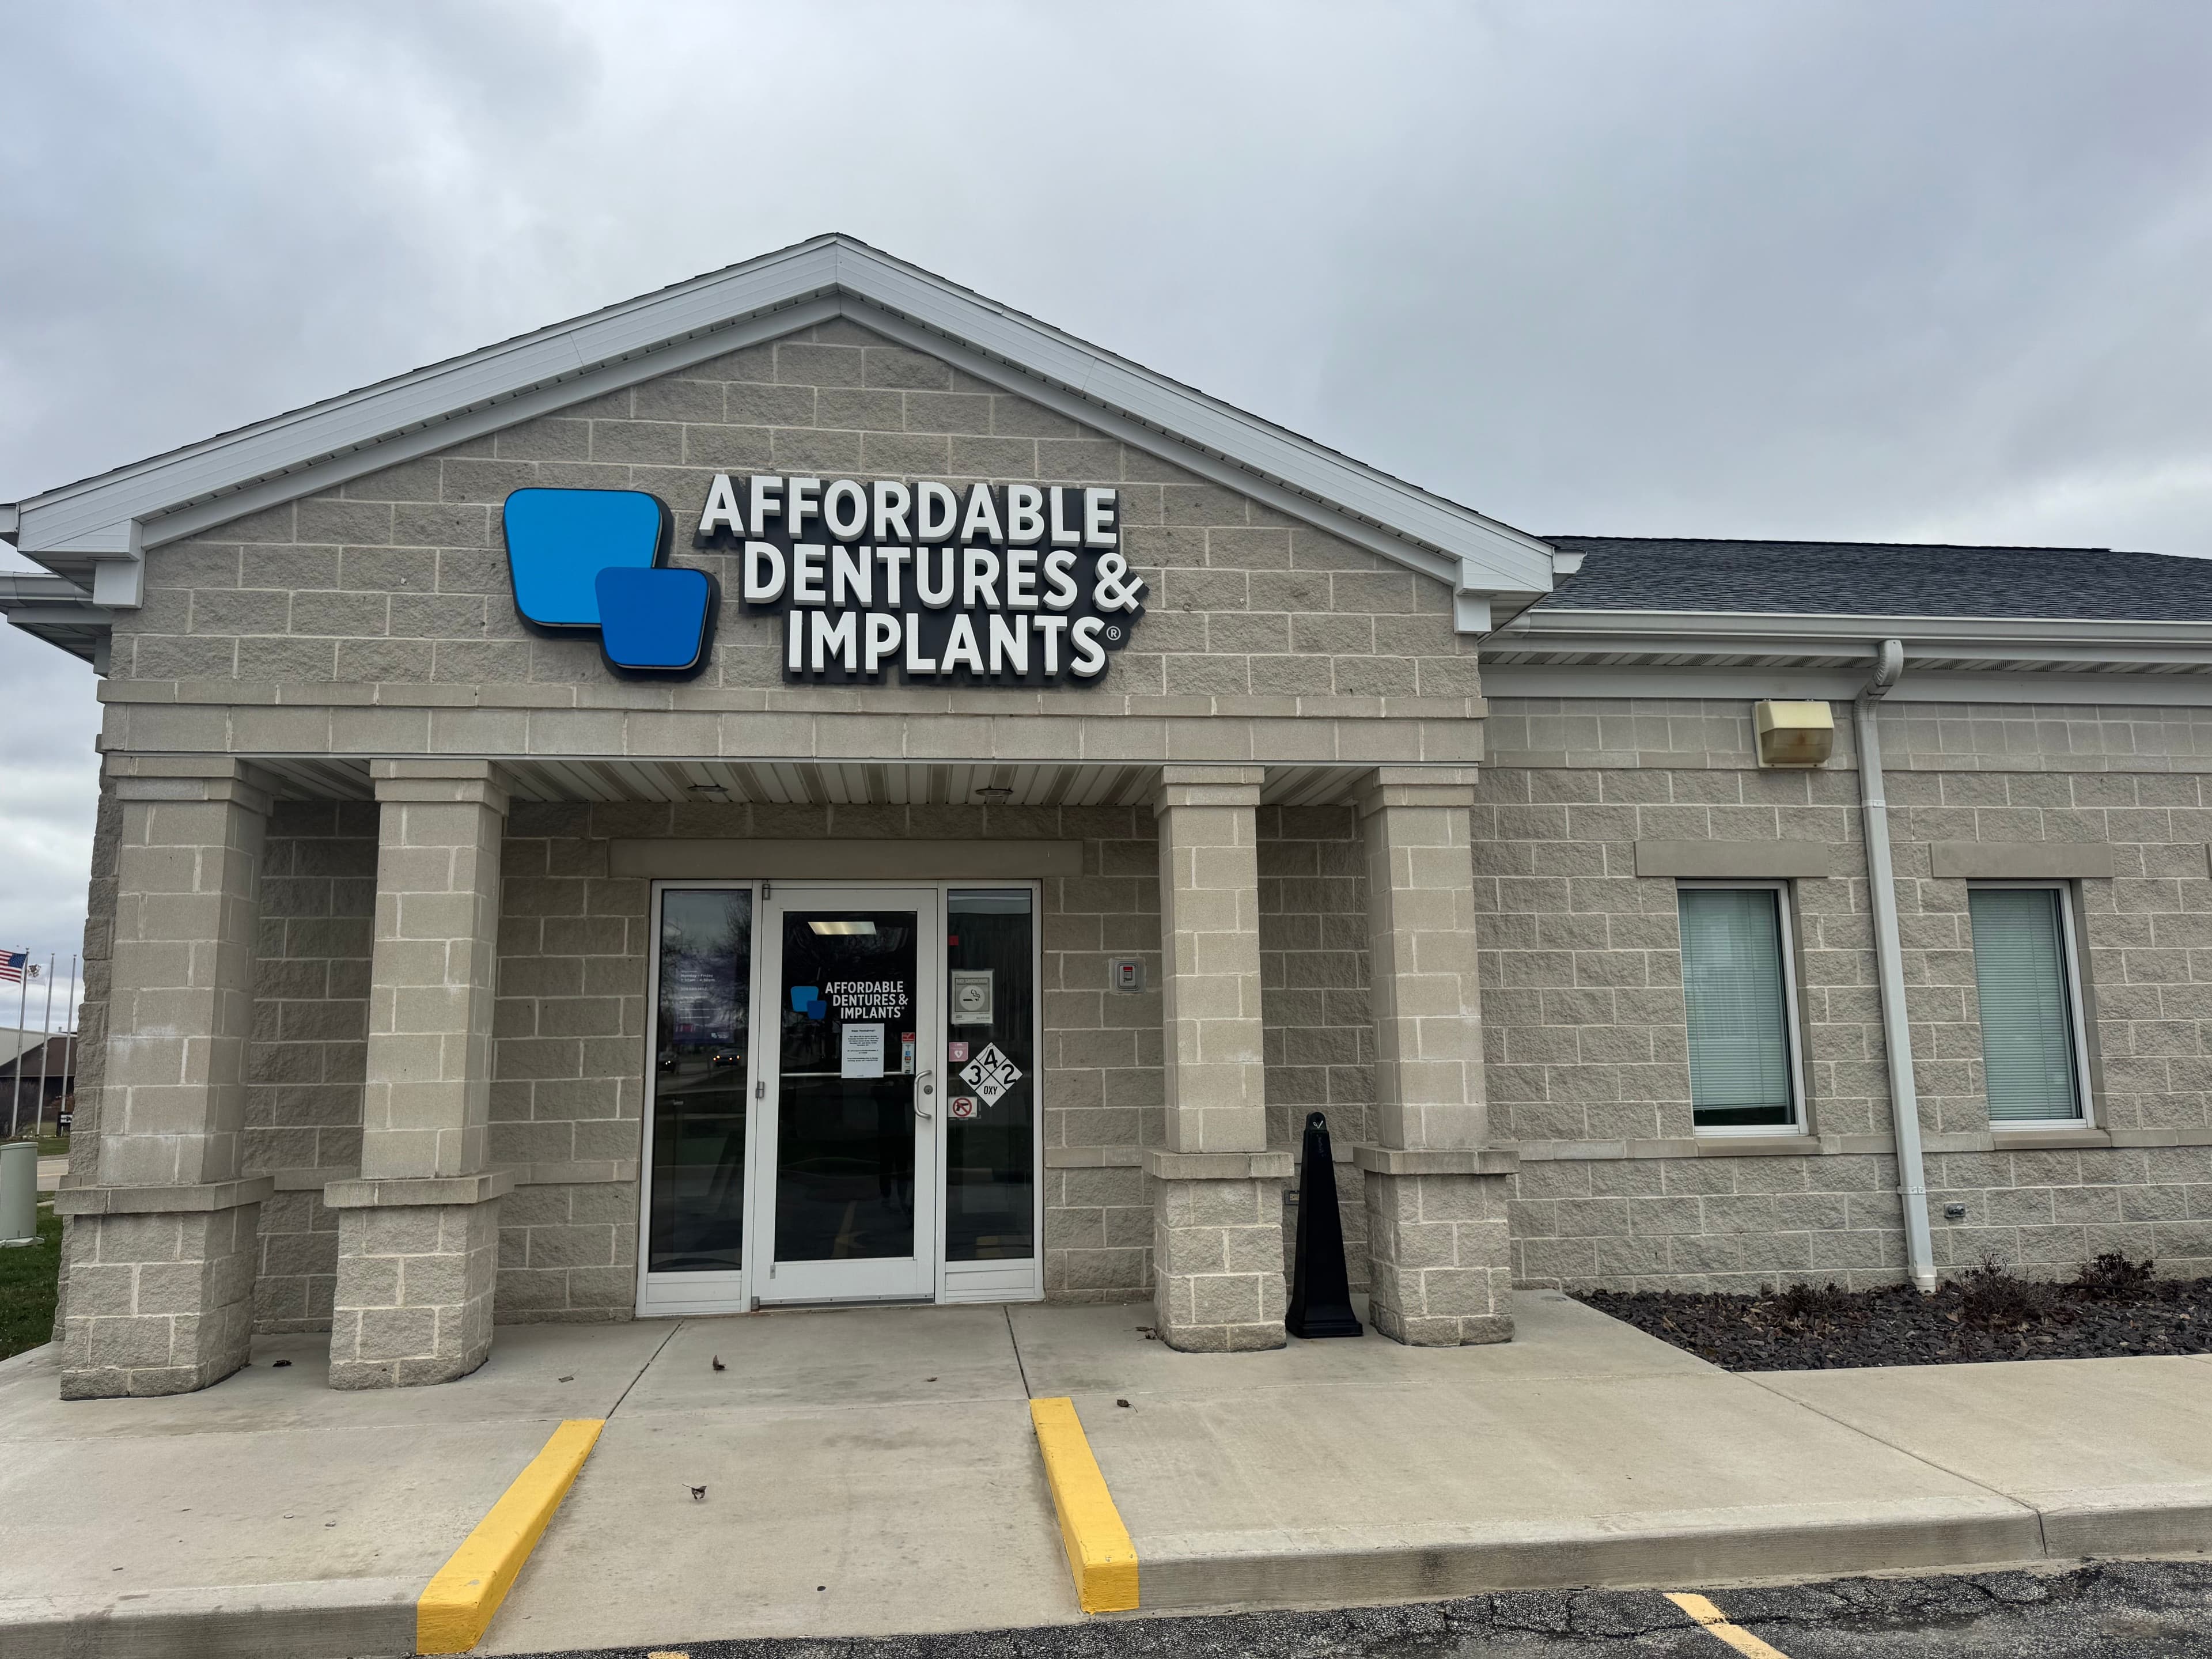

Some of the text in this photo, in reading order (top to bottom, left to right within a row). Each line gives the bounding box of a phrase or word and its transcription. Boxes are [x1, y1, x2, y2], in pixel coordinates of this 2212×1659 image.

[699, 474, 1117, 548] AFFORDABLE
[744, 541, 1145, 614] DENTURES &
[825, 981, 904, 994] AFFORDABLE
[832, 994, 908, 1006] DENTURES &
[984, 1048, 998, 1069] 4
[968, 1065, 981, 1085] 3
[1001, 1064, 1017, 1084] 2
[984, 1085, 998, 1095] OXY
